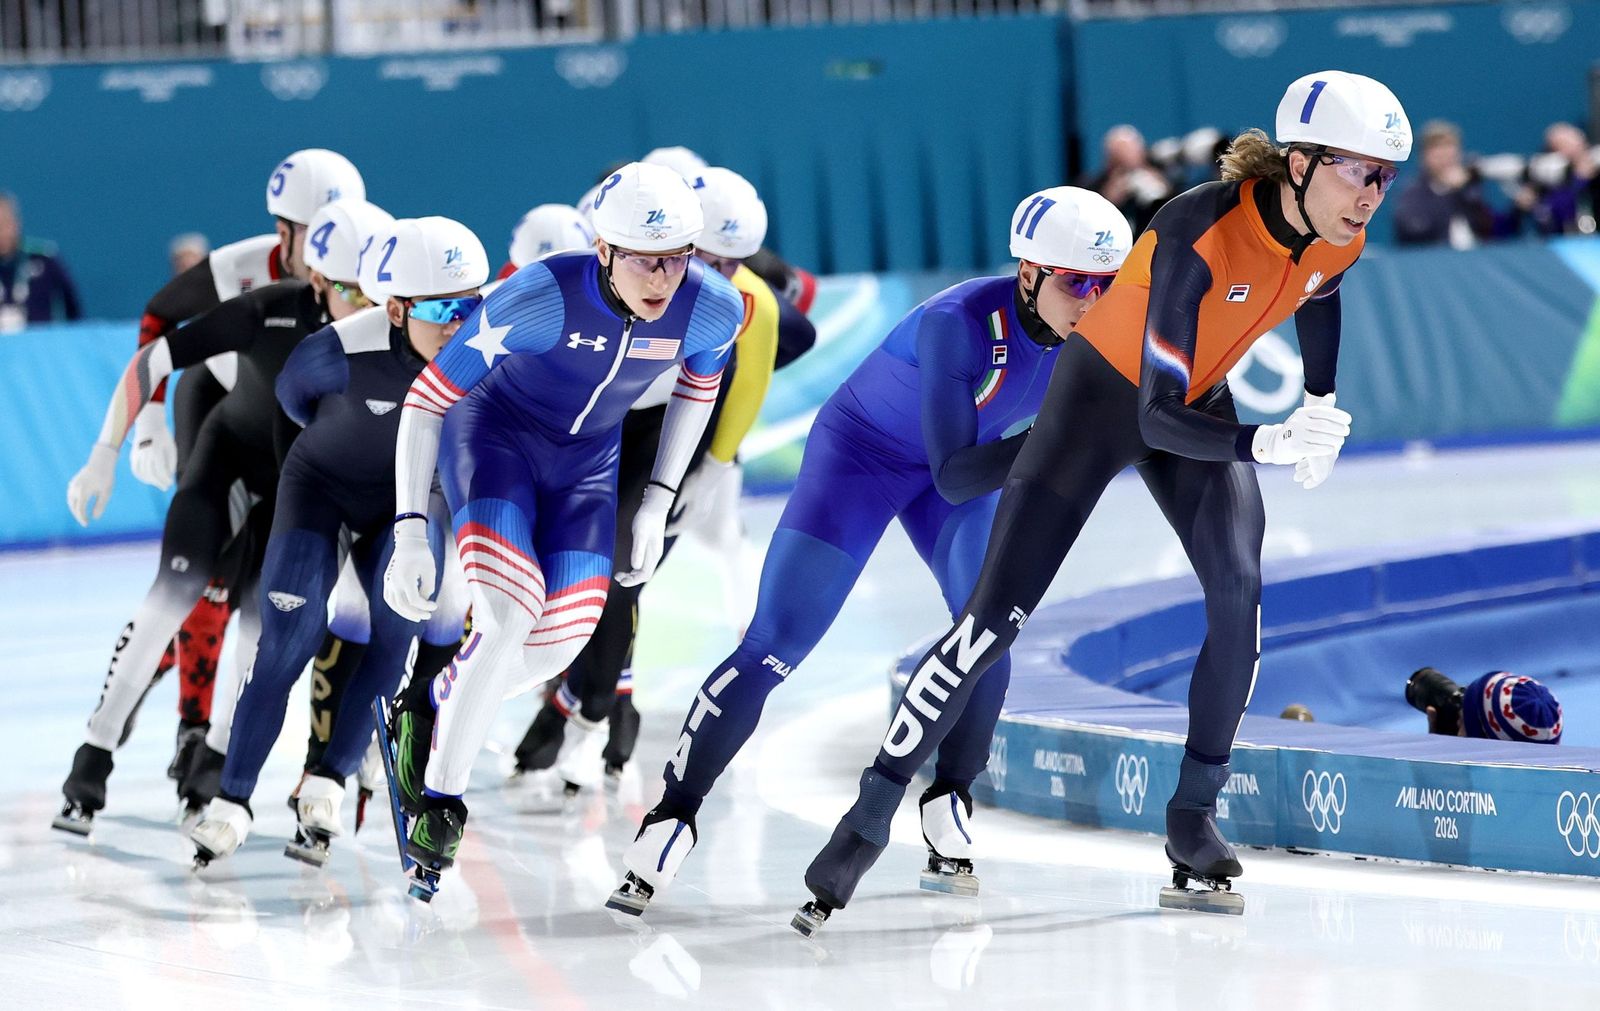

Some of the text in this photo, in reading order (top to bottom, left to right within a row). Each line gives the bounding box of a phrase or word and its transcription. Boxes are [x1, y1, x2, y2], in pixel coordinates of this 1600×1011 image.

[1300, 81, 1327, 124] 1
[270, 162, 294, 197] 5
[594, 173, 622, 210] 3
[1016, 195, 1057, 240] 11
[310, 221, 336, 260] 4
[377, 236, 398, 282] 2
[761, 654, 792, 678] FILA
[876, 612, 998, 758] NED
[667, 666, 740, 783] ITA
[1221, 773, 1261, 796] ORTINA
[1395, 786, 1498, 816] MILANO CORTINA
[1434, 816, 1459, 839] 2026
